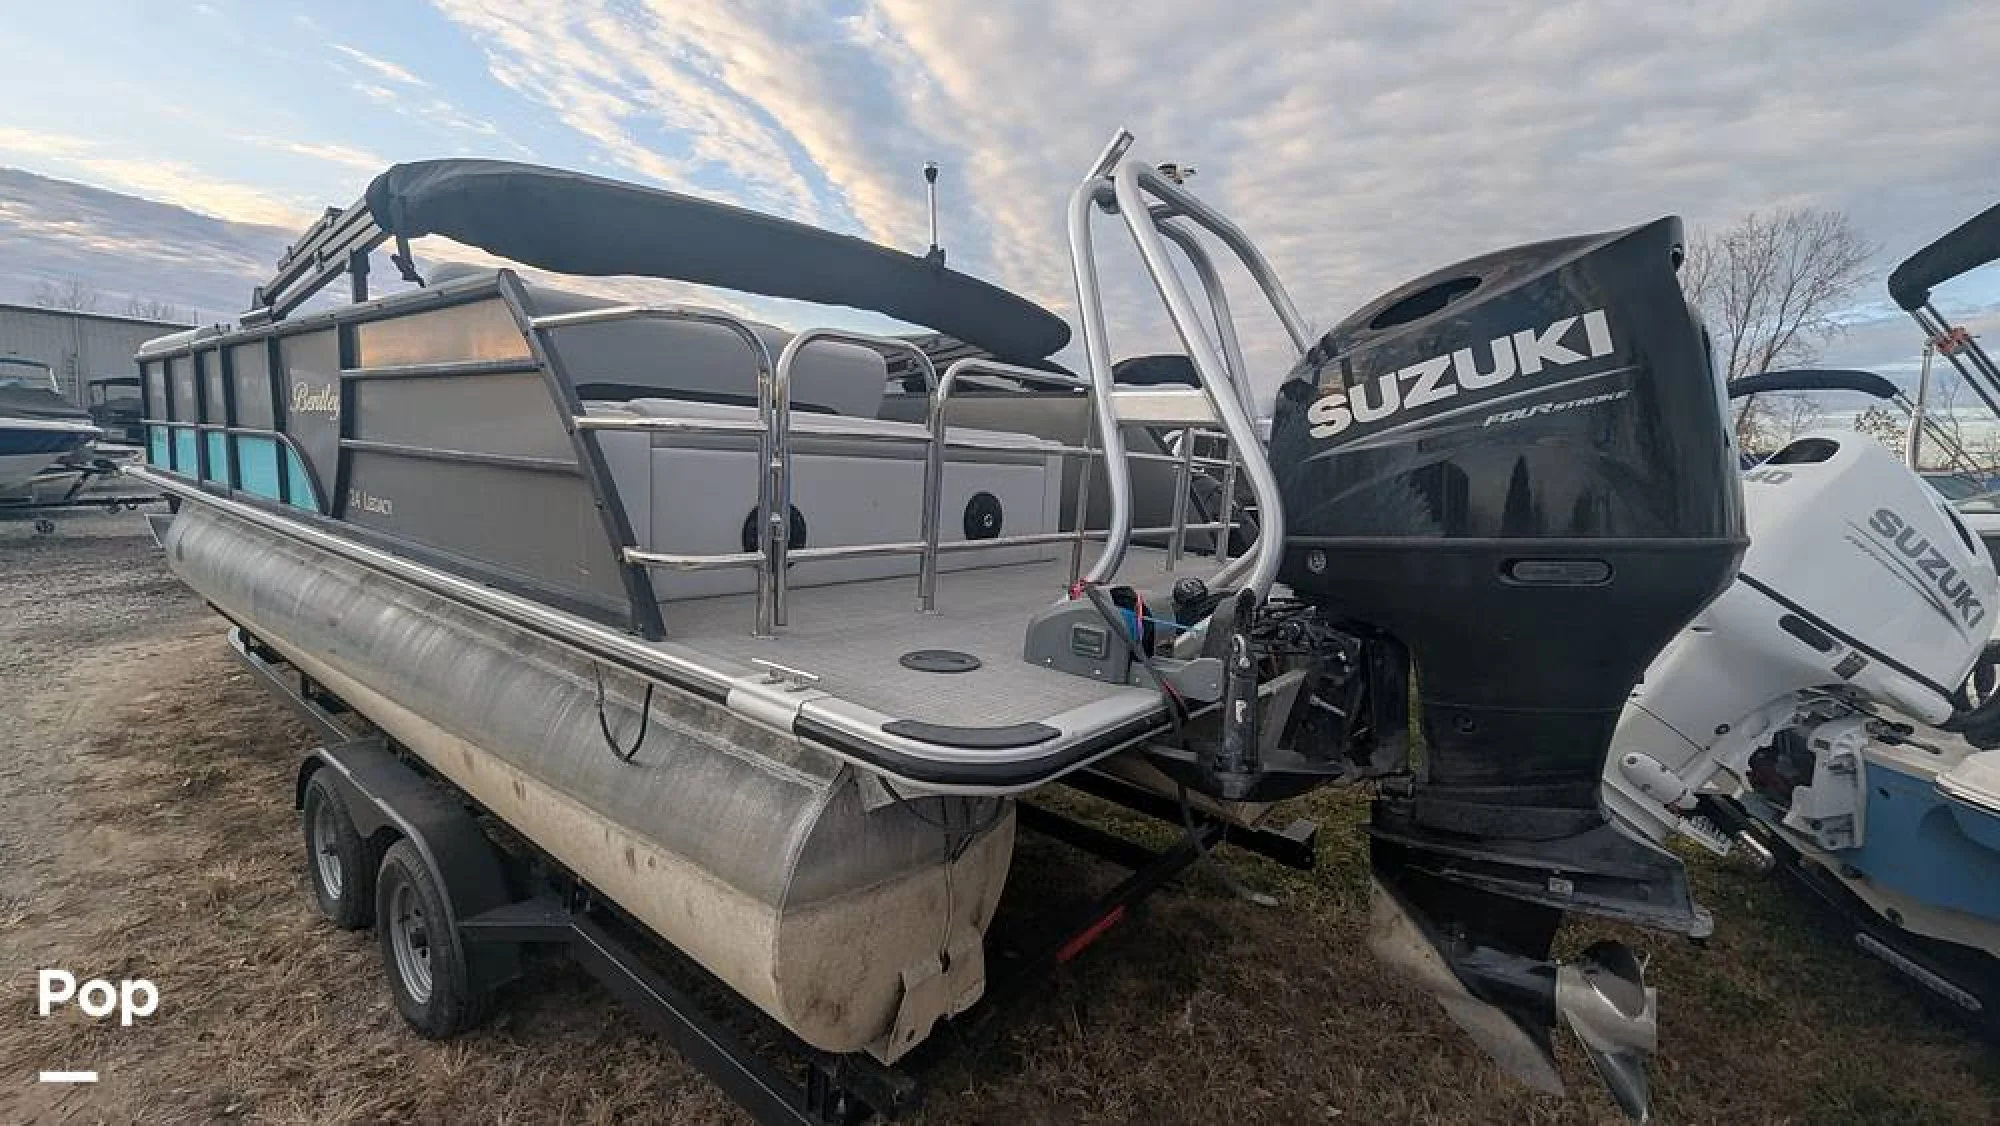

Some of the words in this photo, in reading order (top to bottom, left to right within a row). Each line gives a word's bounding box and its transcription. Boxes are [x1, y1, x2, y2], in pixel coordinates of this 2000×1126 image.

[291, 381, 339, 421] Bentley
[1307, 308, 1614, 439] SUZUKI
[1868, 507, 1985, 629] SUZUKI
